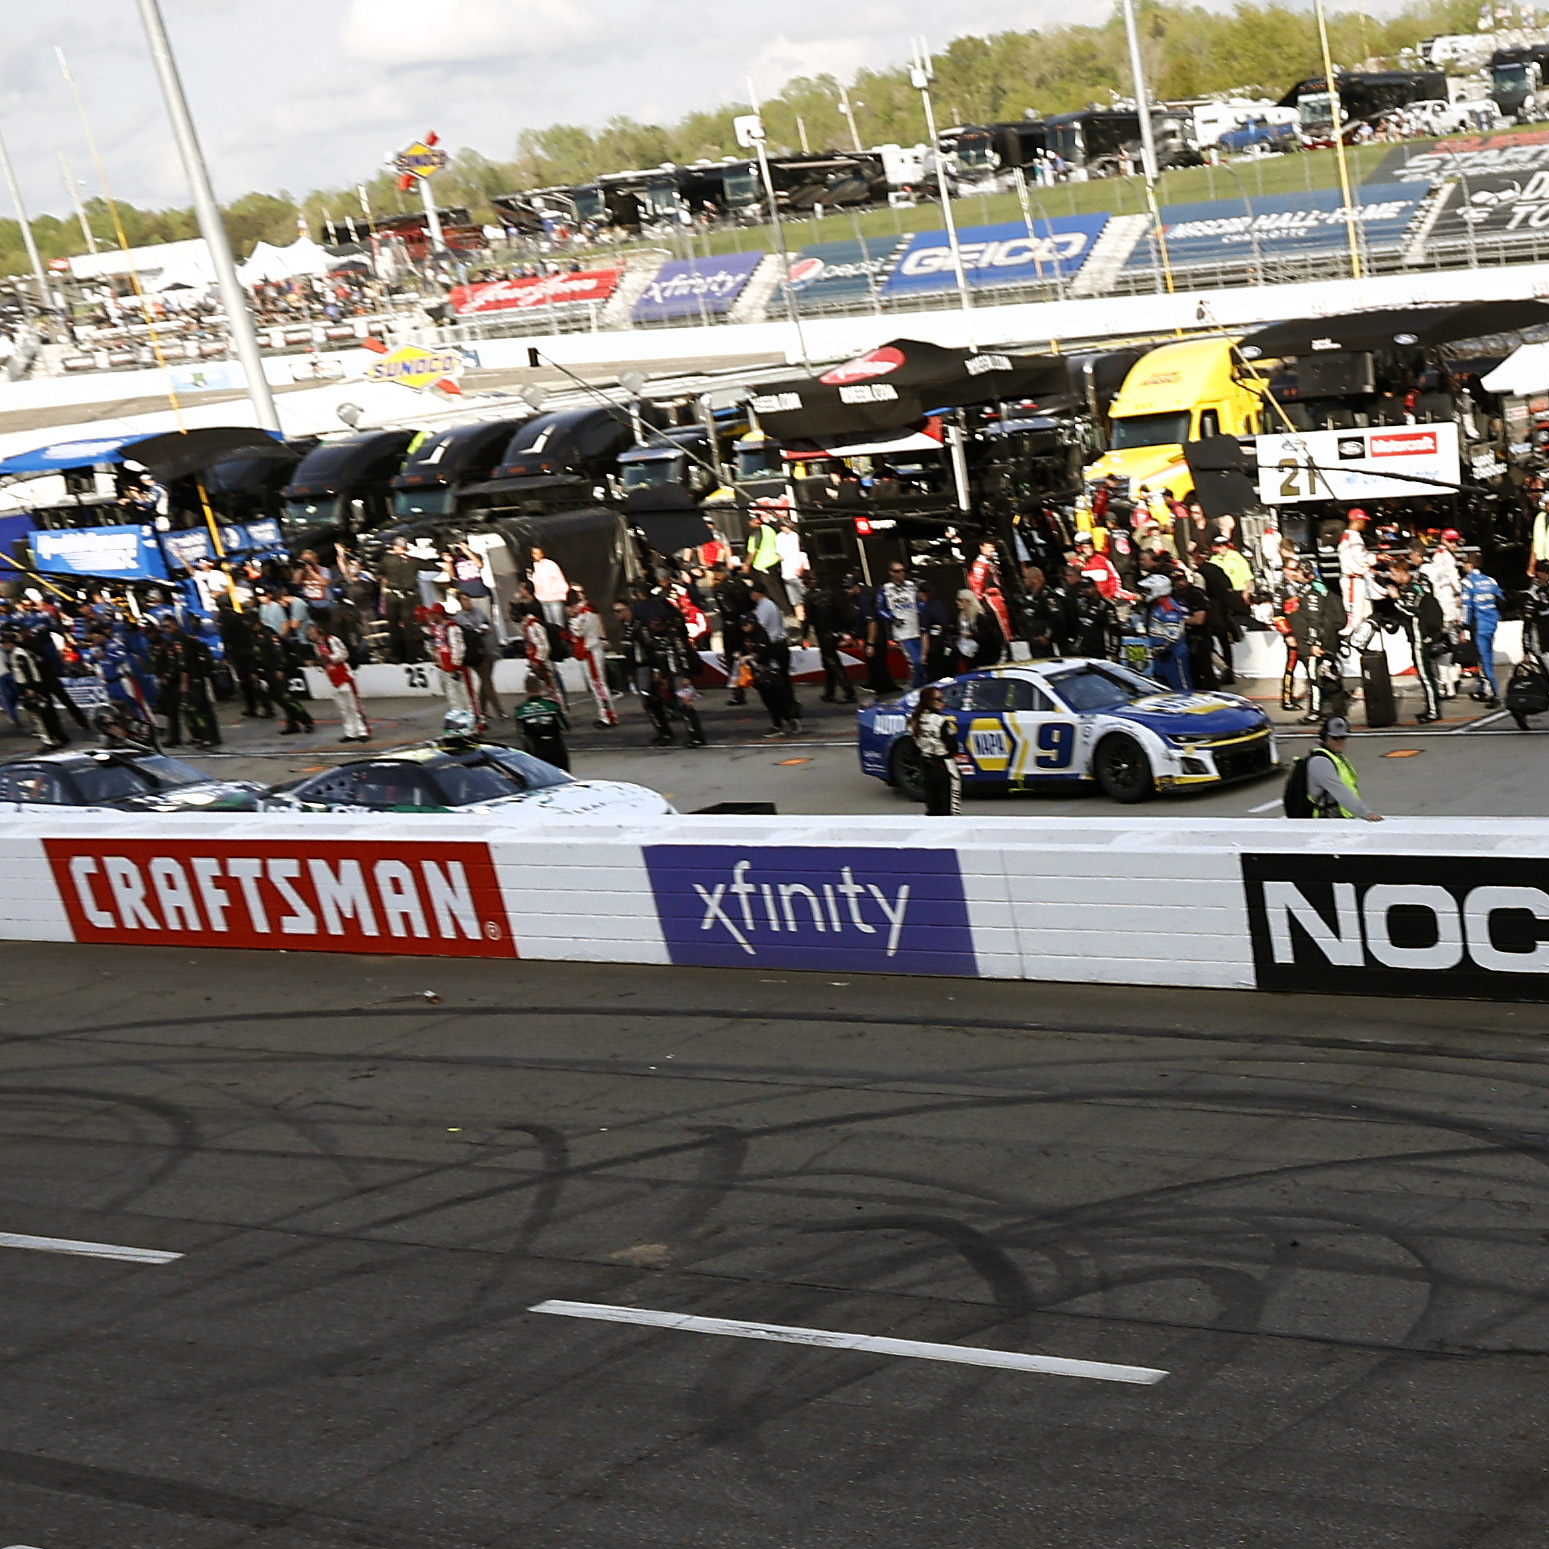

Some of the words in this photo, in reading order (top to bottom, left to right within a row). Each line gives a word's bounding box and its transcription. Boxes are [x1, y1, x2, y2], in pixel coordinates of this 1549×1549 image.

[902, 231, 1088, 276] GEICO
[646, 269, 748, 302] xfinity
[373, 355, 454, 379] SUNOCO
[1277, 458, 1317, 496] 21
[405, 666, 429, 690] 25
[970, 728, 1010, 757] NAPA
[1036, 721, 1076, 769] 9
[691, 858, 910, 957] xfinity
